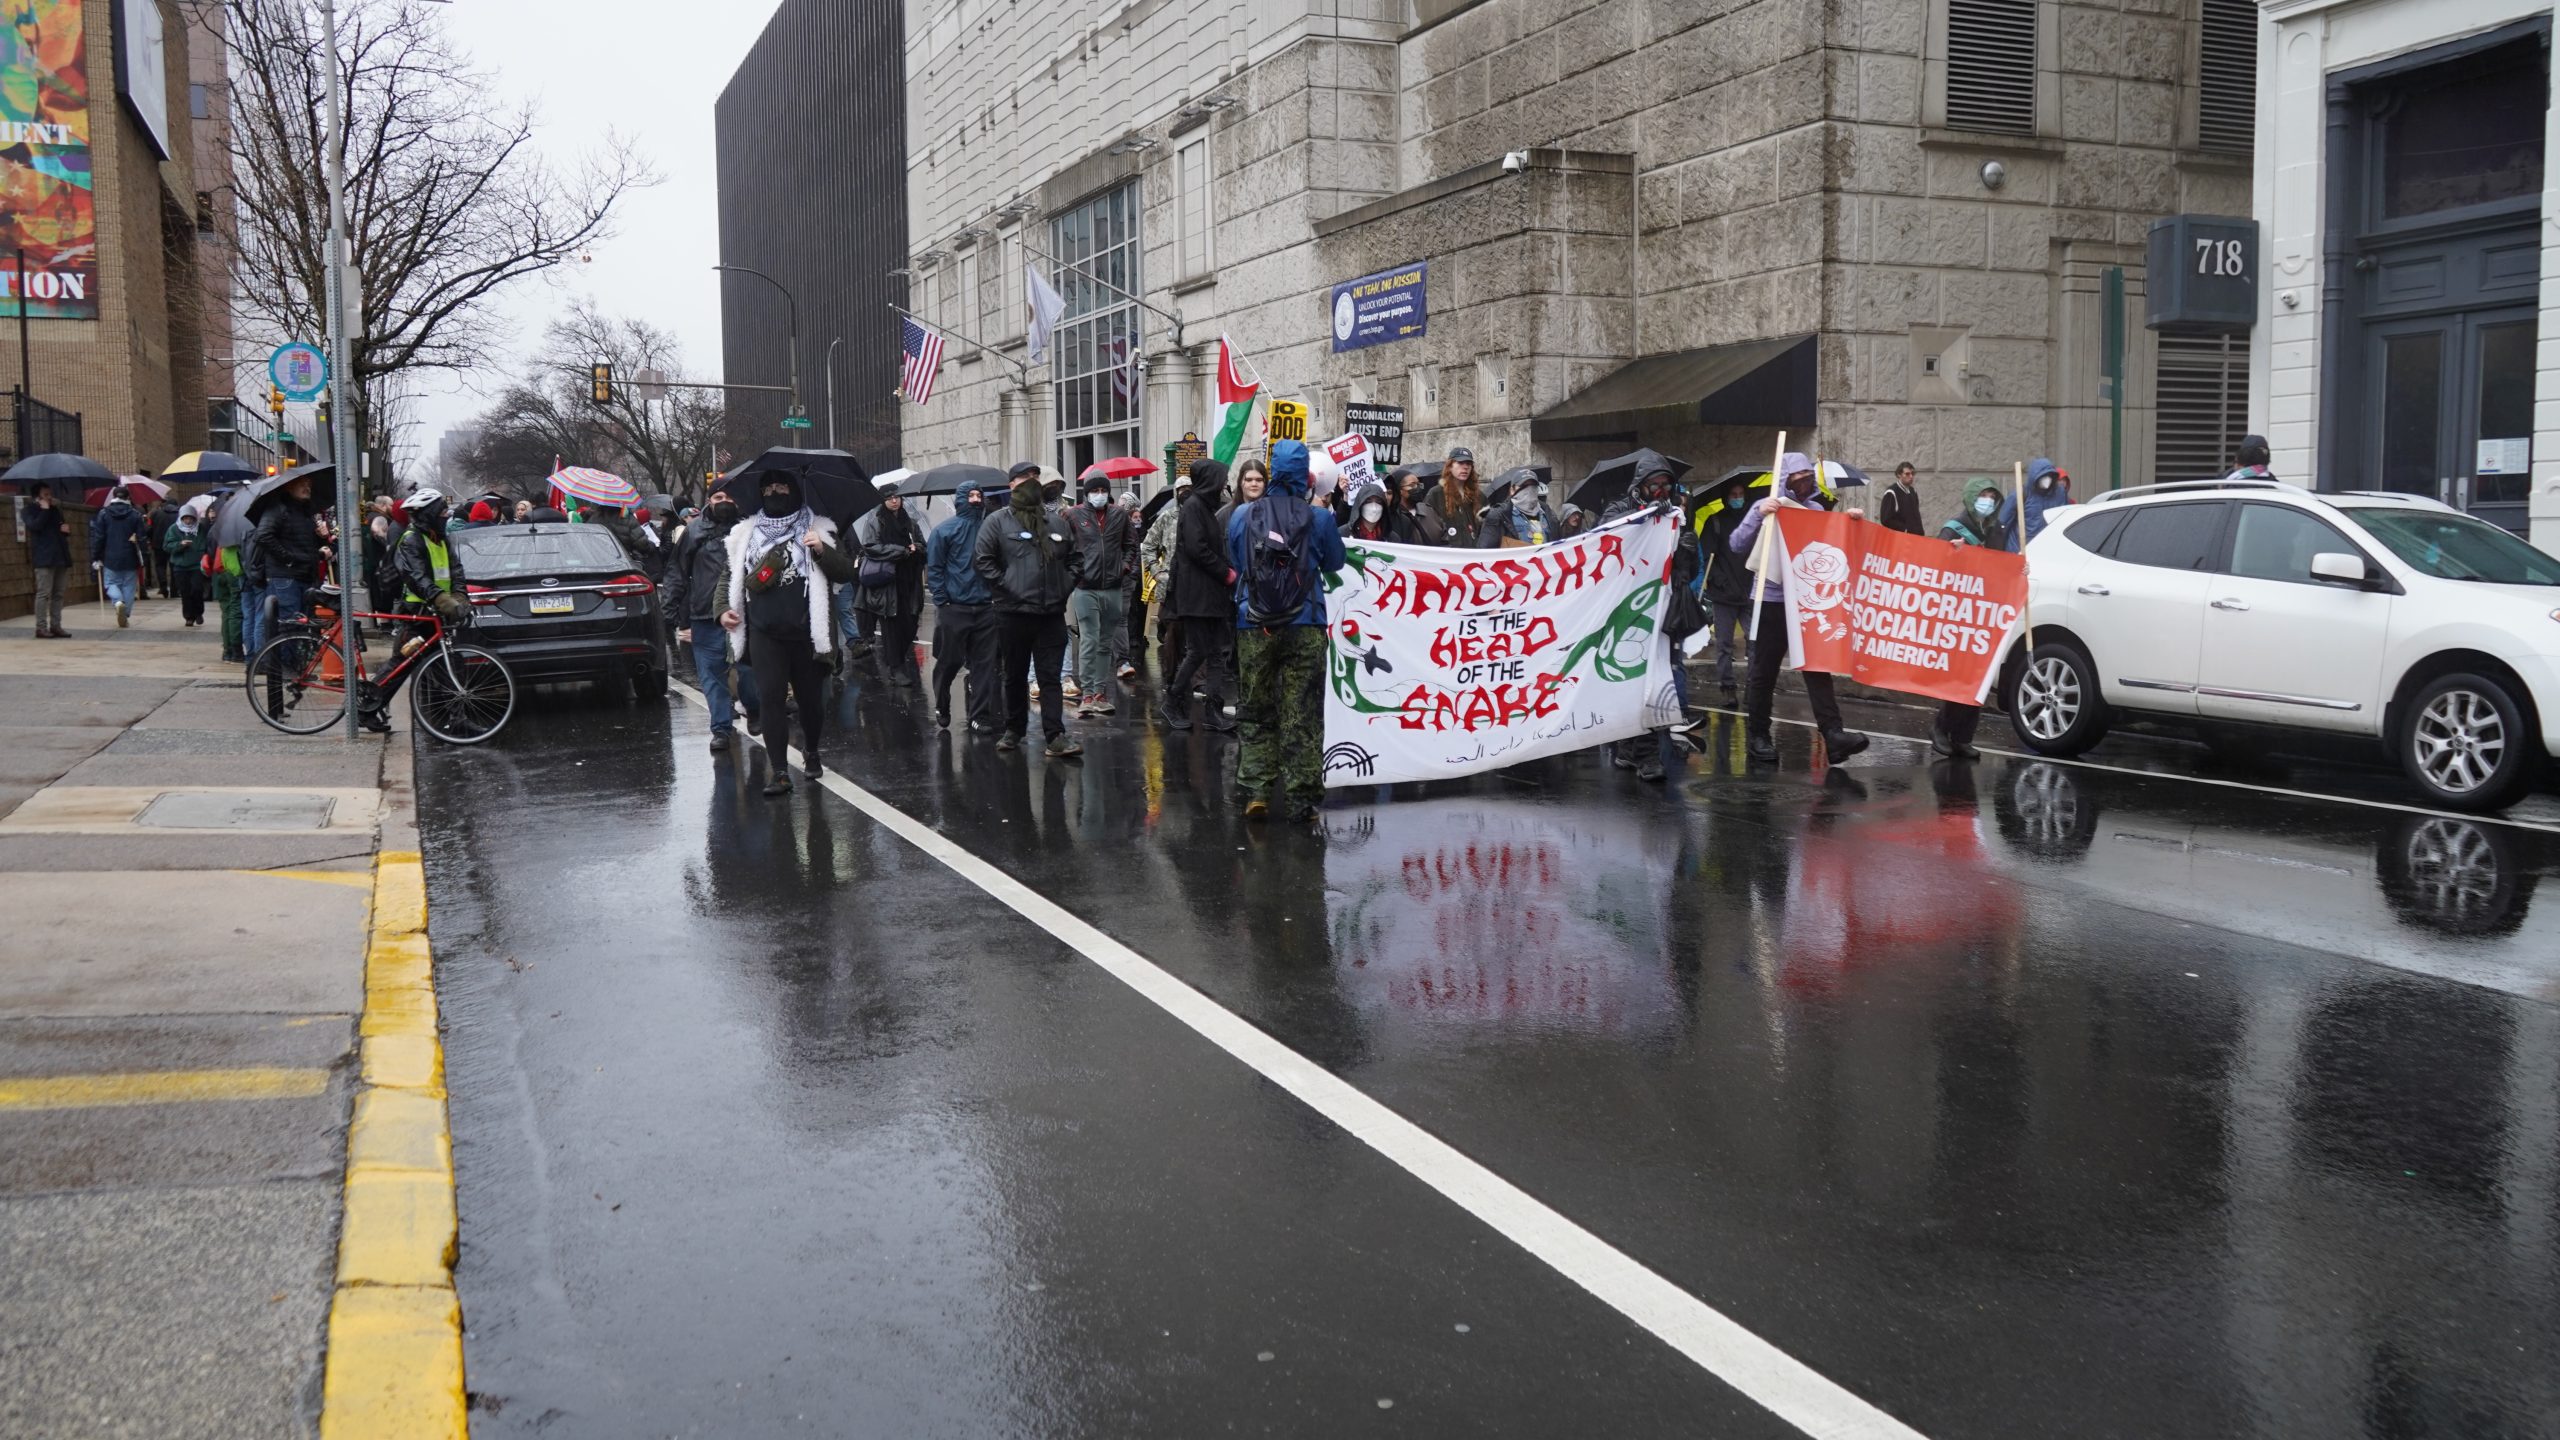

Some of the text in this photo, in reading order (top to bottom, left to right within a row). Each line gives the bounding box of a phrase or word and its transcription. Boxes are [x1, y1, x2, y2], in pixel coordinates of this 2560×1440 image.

[2196, 238, 2243, 275] 718
[1359, 302, 1375, 311] UNLOCK
[1376, 298, 1388, 307] YOUR
[1359, 313, 1379, 324] Discover
[1379, 310, 1390, 321] your
[1347, 409, 1403, 423] COLONIALISM
[1349, 423, 1400, 438] MUST END
[1332, 436, 1360, 455] ABOLISH
[1342, 446, 1354, 458] ICE
[1344, 458, 1366, 475] FUND
[1350, 467, 1367, 482] OUR
[1373, 534, 1625, 618] AMERIKA
[1861, 552, 1985, 597] PHILADELPHIA
[1855, 574, 2017, 631] DEMOCRATIC
[1459, 611, 1527, 636] IS THE
[1852, 602, 1991, 655] SOCIALISTS
[1429, 615, 1558, 671] HEAD
[1852, 632, 1949, 672] OF AMERICA
[1457, 660, 1525, 684] OF THE
[1397, 671, 1564, 735] SNAKE
